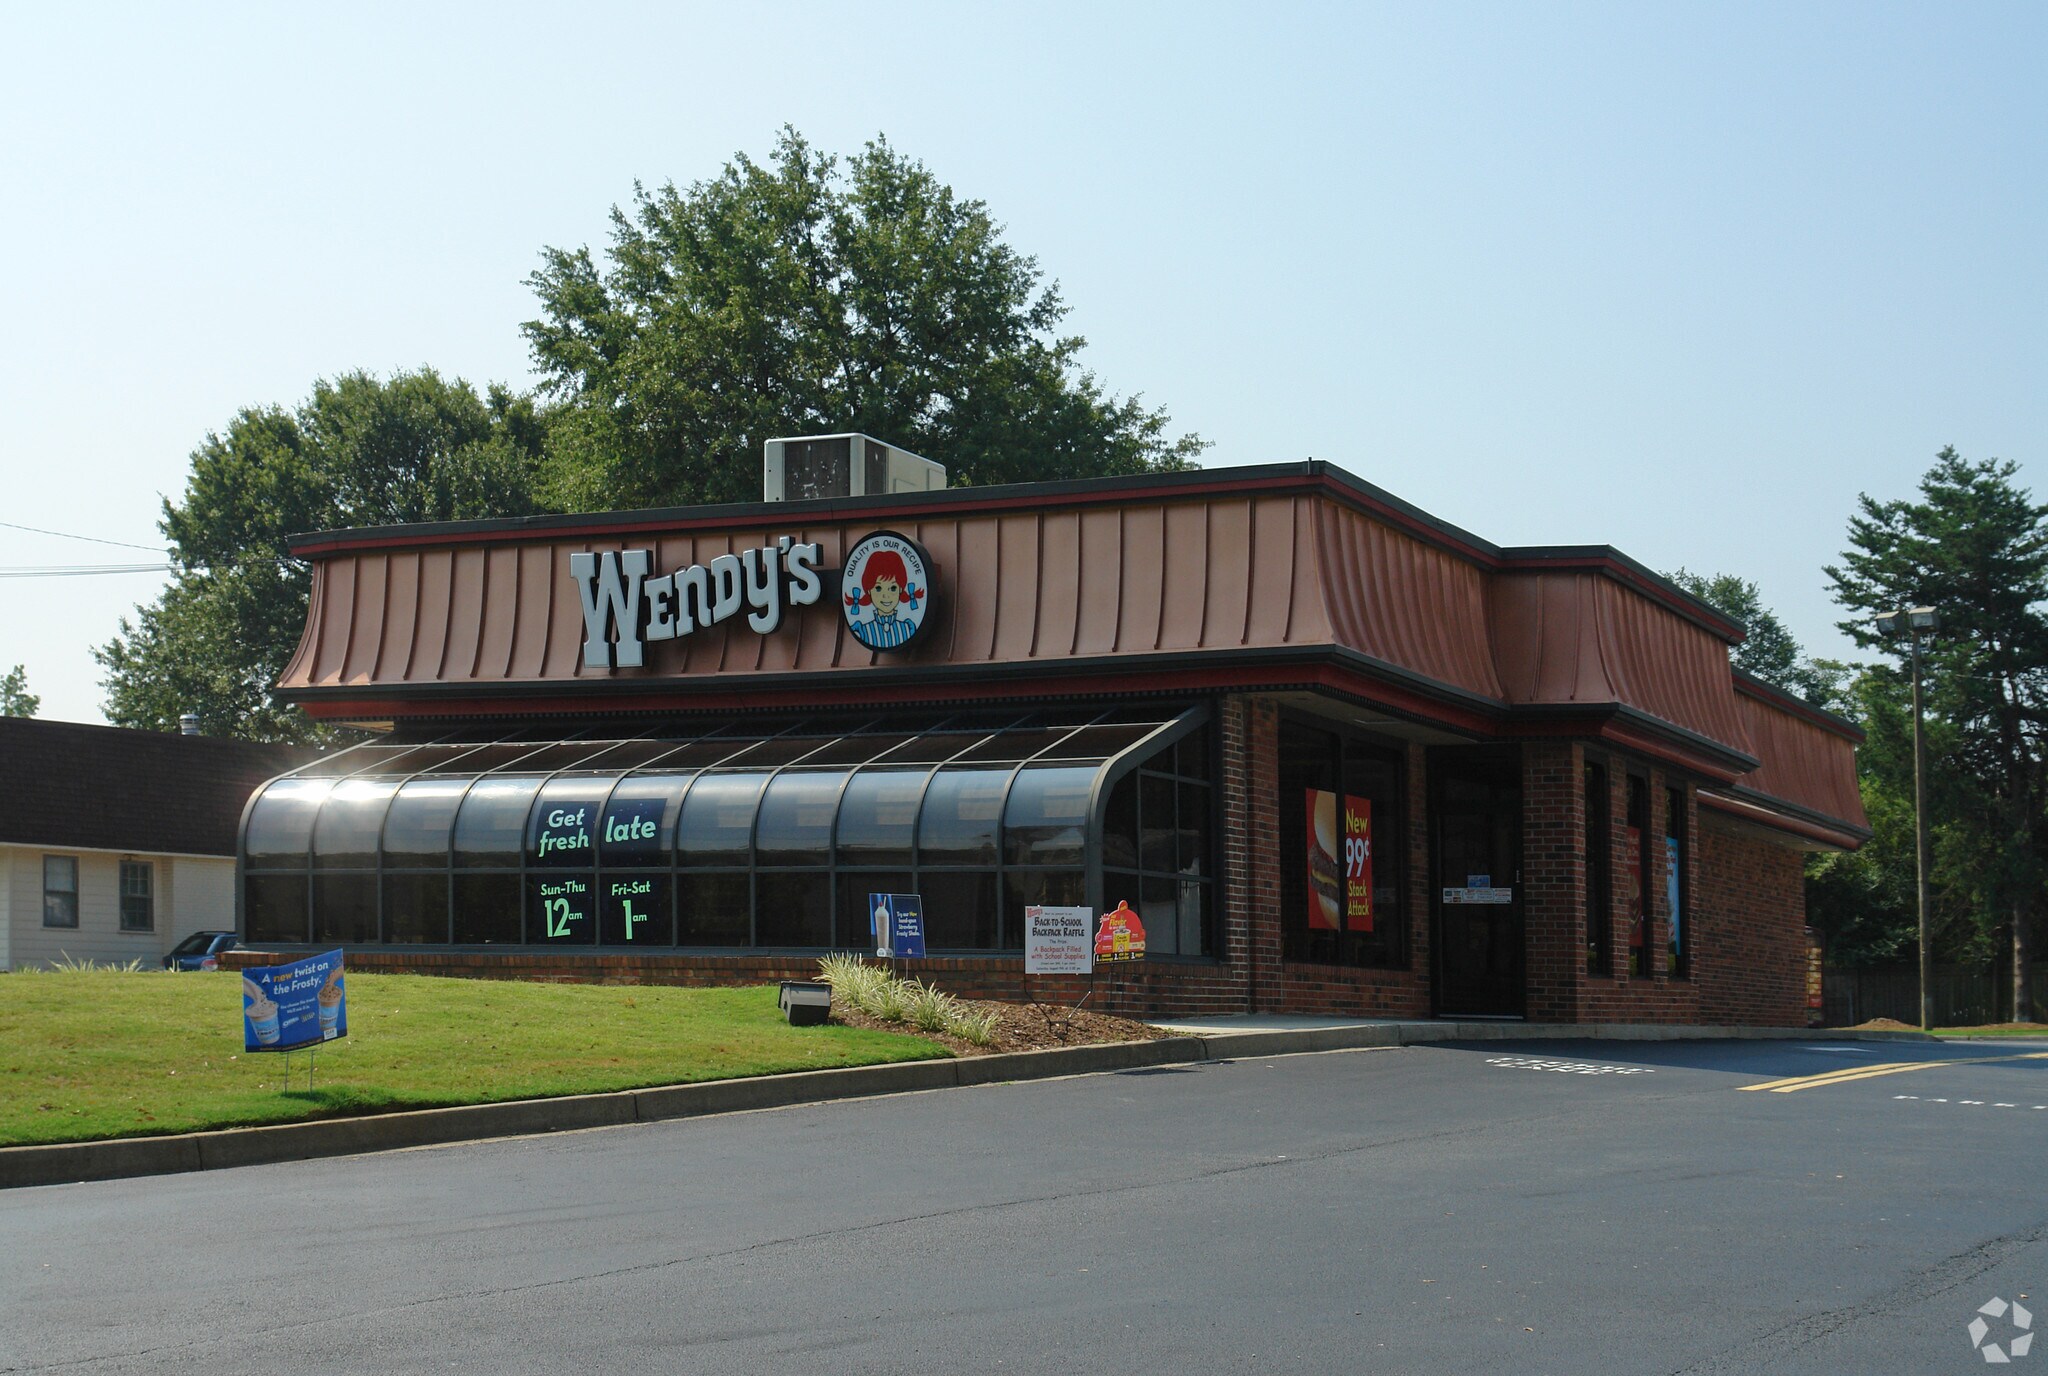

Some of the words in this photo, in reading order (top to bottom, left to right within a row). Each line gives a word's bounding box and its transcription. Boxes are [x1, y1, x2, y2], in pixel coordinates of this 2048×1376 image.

[847, 545, 870, 577] QUALITY
[872, 540, 880, 548] IS
[883, 540, 900, 550] OUR
[901, 546, 922, 575] RECIPE
[570, 536, 822, 667] Wendy's
[548, 808, 585, 828] Get
[605, 815, 657, 843] late
[1346, 808, 1368, 833] New
[538, 828, 589, 857] fresh
[1345, 837, 1370, 878] 99¢
[541, 880, 586, 896] Sun-Thu
[612, 881, 651, 896] Fri-Sat
[1348, 880, 1367, 897] Stack
[1347, 899, 1370, 916] Attack
[262, 973, 271, 984] A
[273, 973, 293, 983] new
[294, 963, 316, 978] twist
[317, 962, 329, 971] on
[273, 983, 290, 995] the
